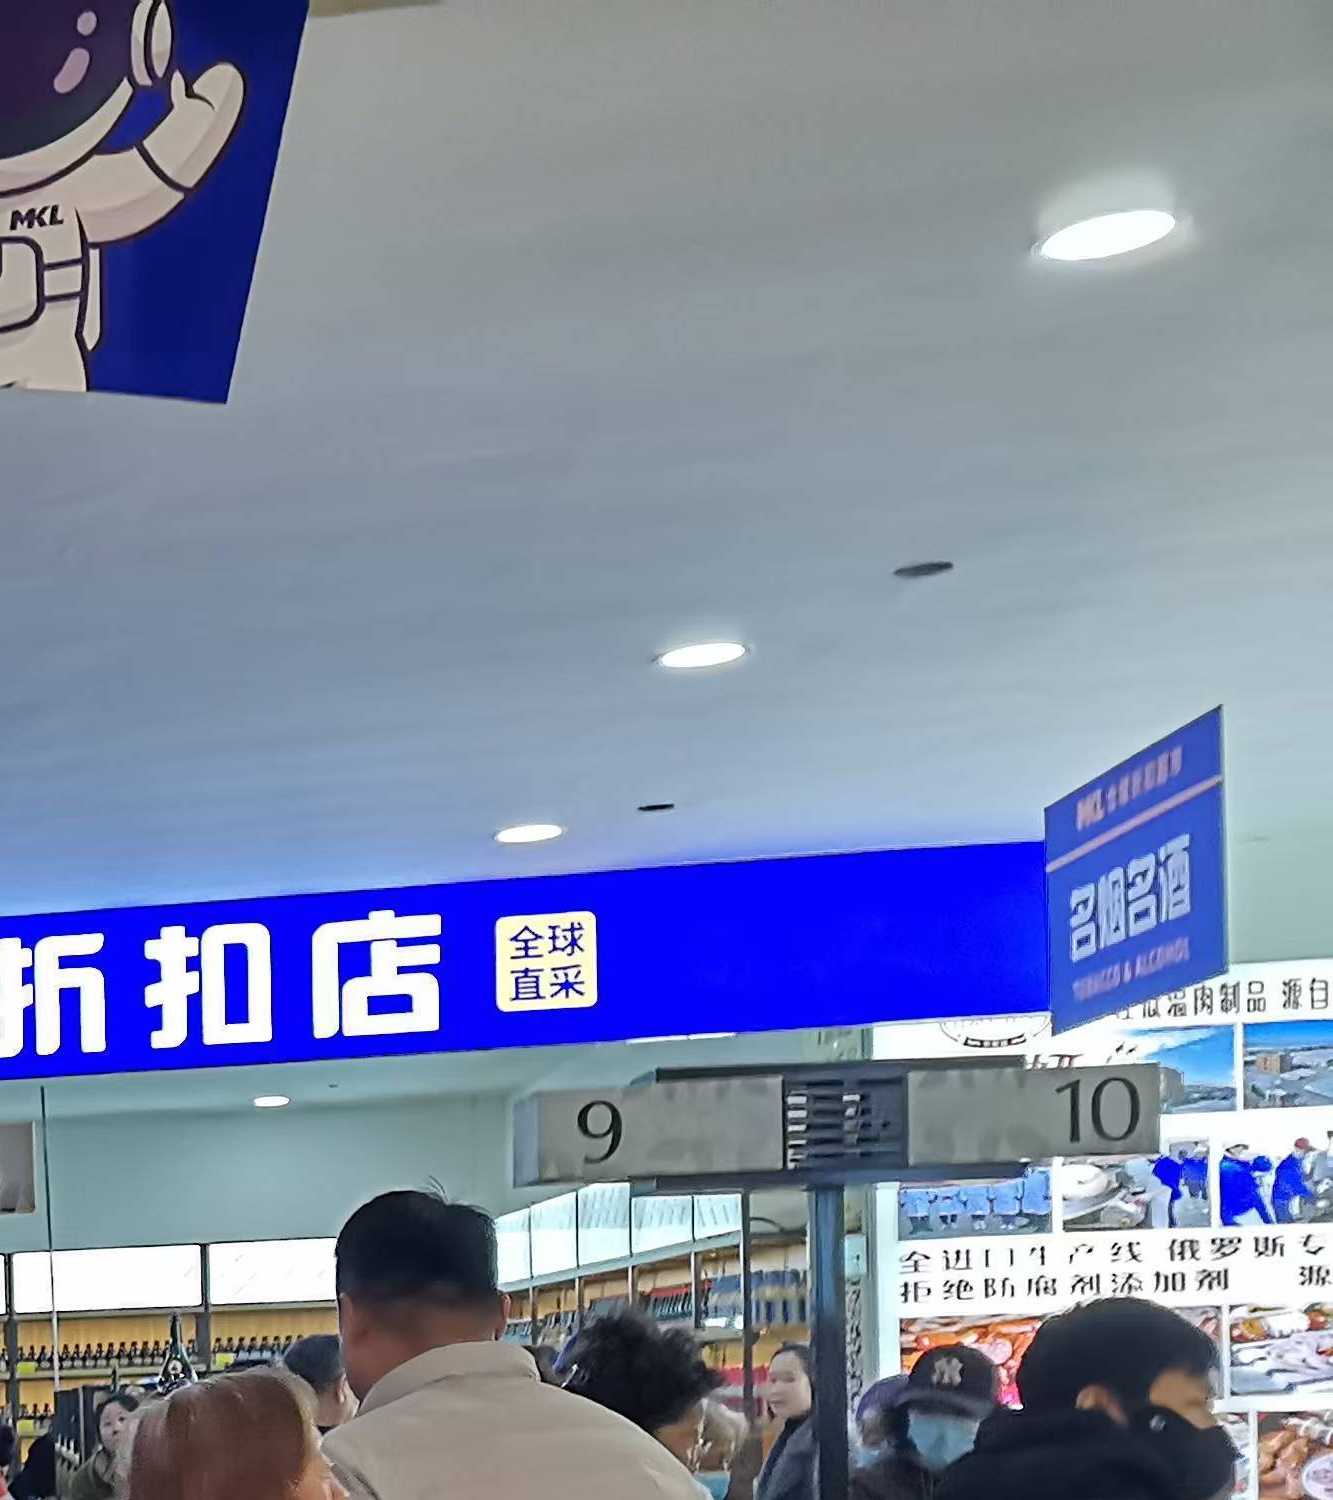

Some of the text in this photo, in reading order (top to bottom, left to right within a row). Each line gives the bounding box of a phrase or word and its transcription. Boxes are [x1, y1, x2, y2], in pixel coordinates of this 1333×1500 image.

[9, 204, 65, 231] MKL
[507, 921, 588, 961] 全球
[508, 965, 588, 1002] 直采
[576, 1075, 1140, 1164] 9 10
